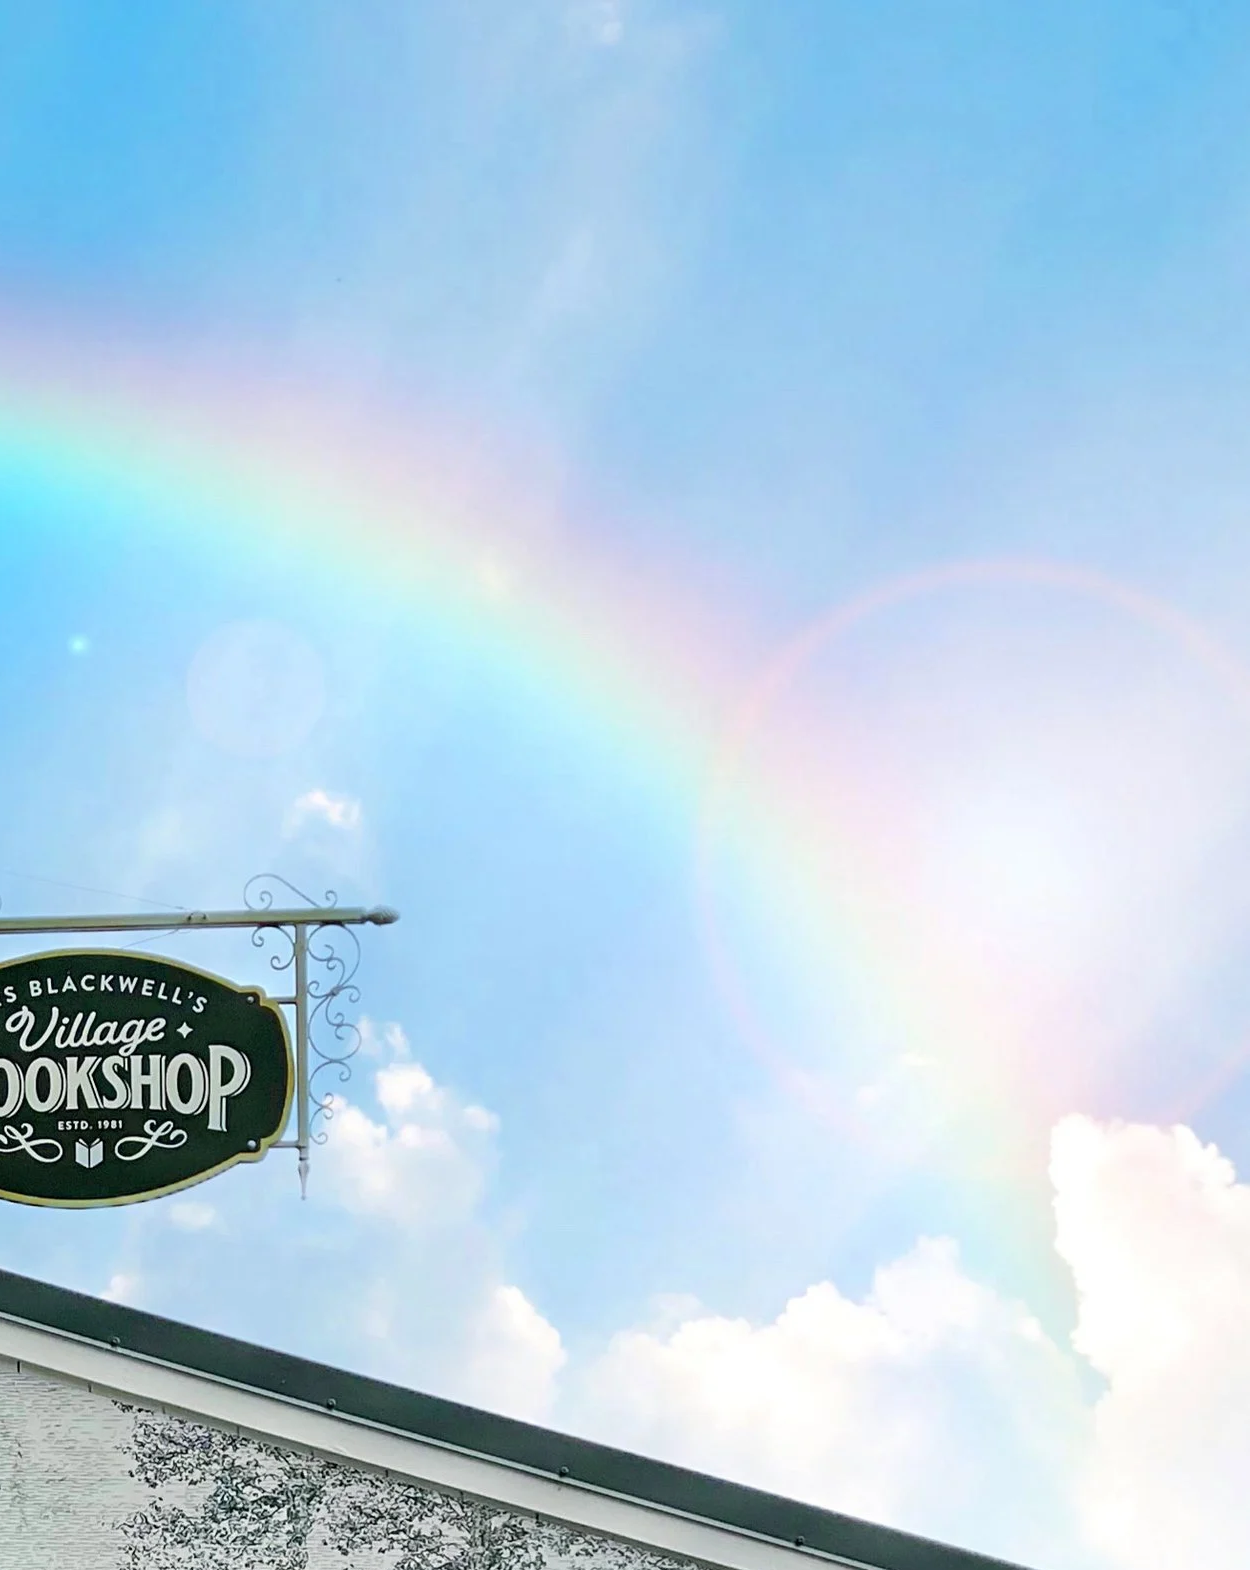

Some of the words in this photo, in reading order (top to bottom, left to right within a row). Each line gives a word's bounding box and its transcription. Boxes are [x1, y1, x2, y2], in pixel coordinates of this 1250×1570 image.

[29, 973, 209, 1014] BLACKWELL'S
[5, 1005, 166, 1055] Village
[57, 1120, 94, 1132] ESTD.
[98, 1119, 123, 1131] 1981
